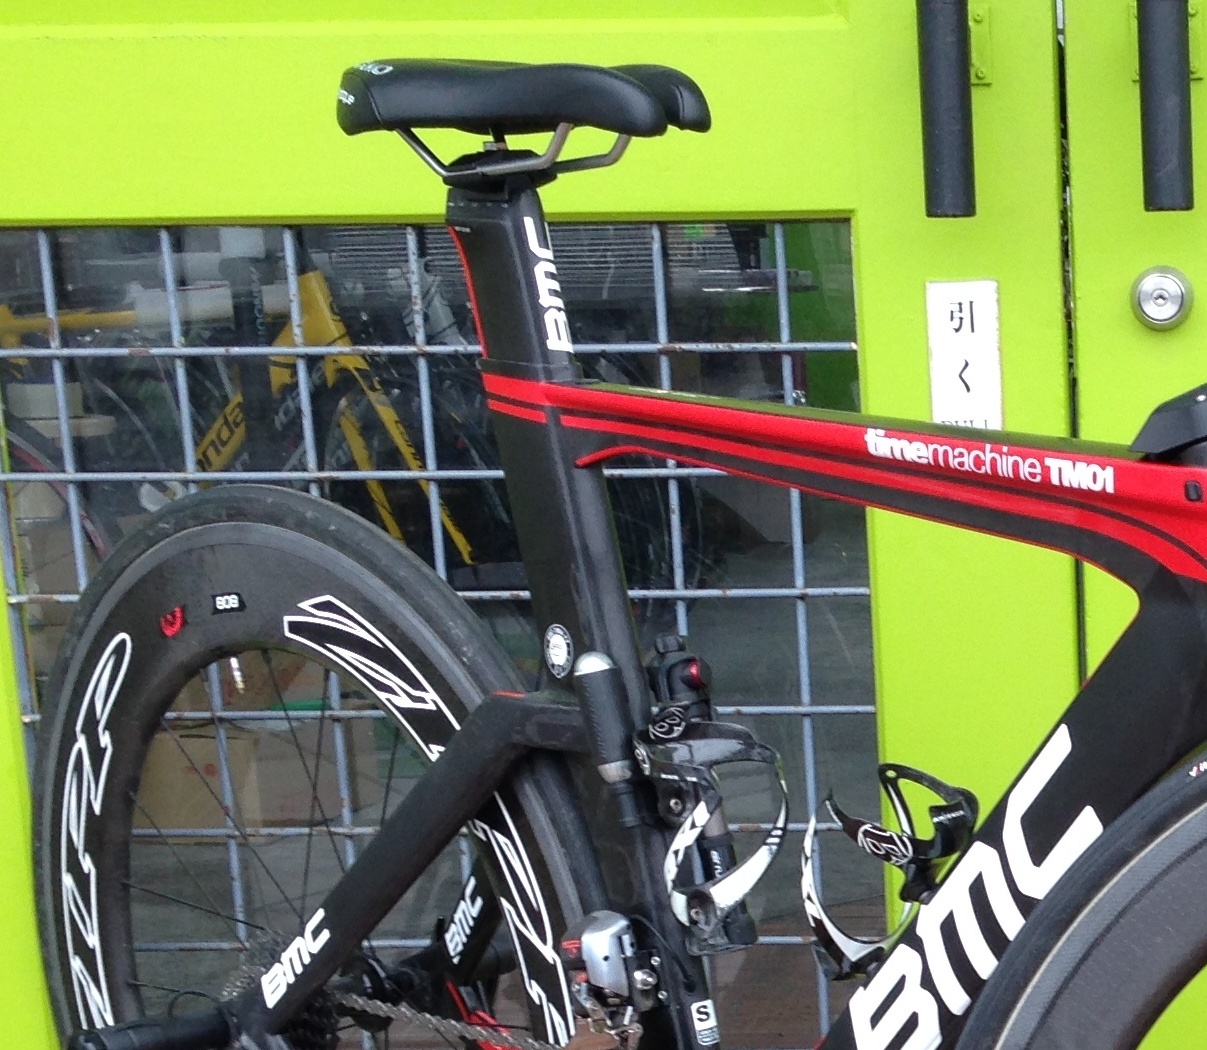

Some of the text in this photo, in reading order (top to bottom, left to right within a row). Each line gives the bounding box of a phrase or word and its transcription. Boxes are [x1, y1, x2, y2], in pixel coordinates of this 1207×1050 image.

[949, 300, 976, 393] 引く
[864, 428, 1115, 494] timemachine TM01
[261, 907, 331, 1009] BMC
[444, 875, 483, 964] BMC
[696, 1003, 711, 1023] S
